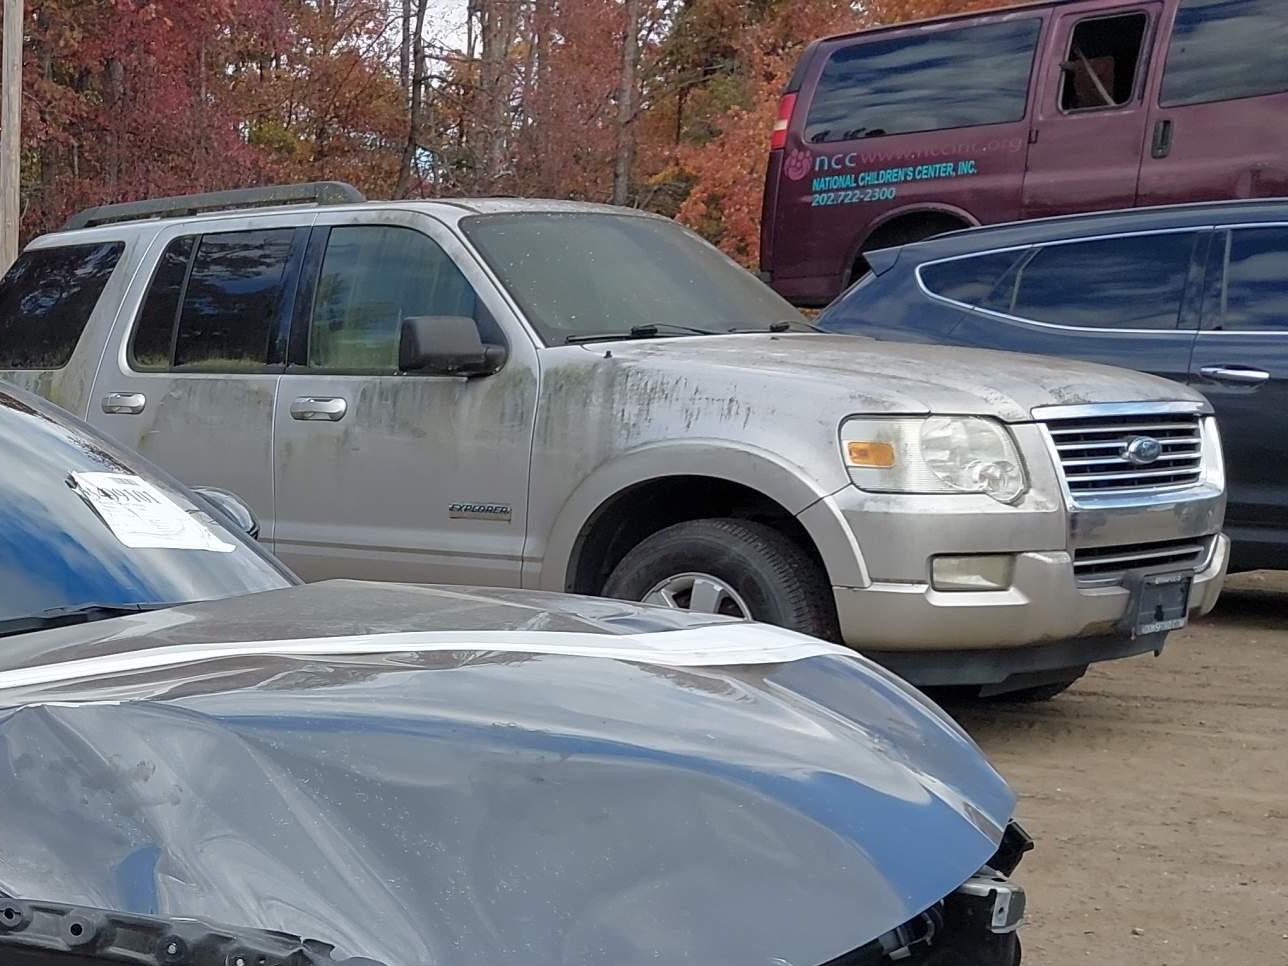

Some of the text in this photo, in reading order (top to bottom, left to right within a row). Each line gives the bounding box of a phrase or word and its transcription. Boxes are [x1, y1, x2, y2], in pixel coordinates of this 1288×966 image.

[814, 152, 857, 171] ncc
[813, 160, 977, 191] NATIONAL CHILDREN'S CENTER, INC.
[812, 187, 896, 206] 202.722-2300
[449, 503, 511, 513] EXPLORER
